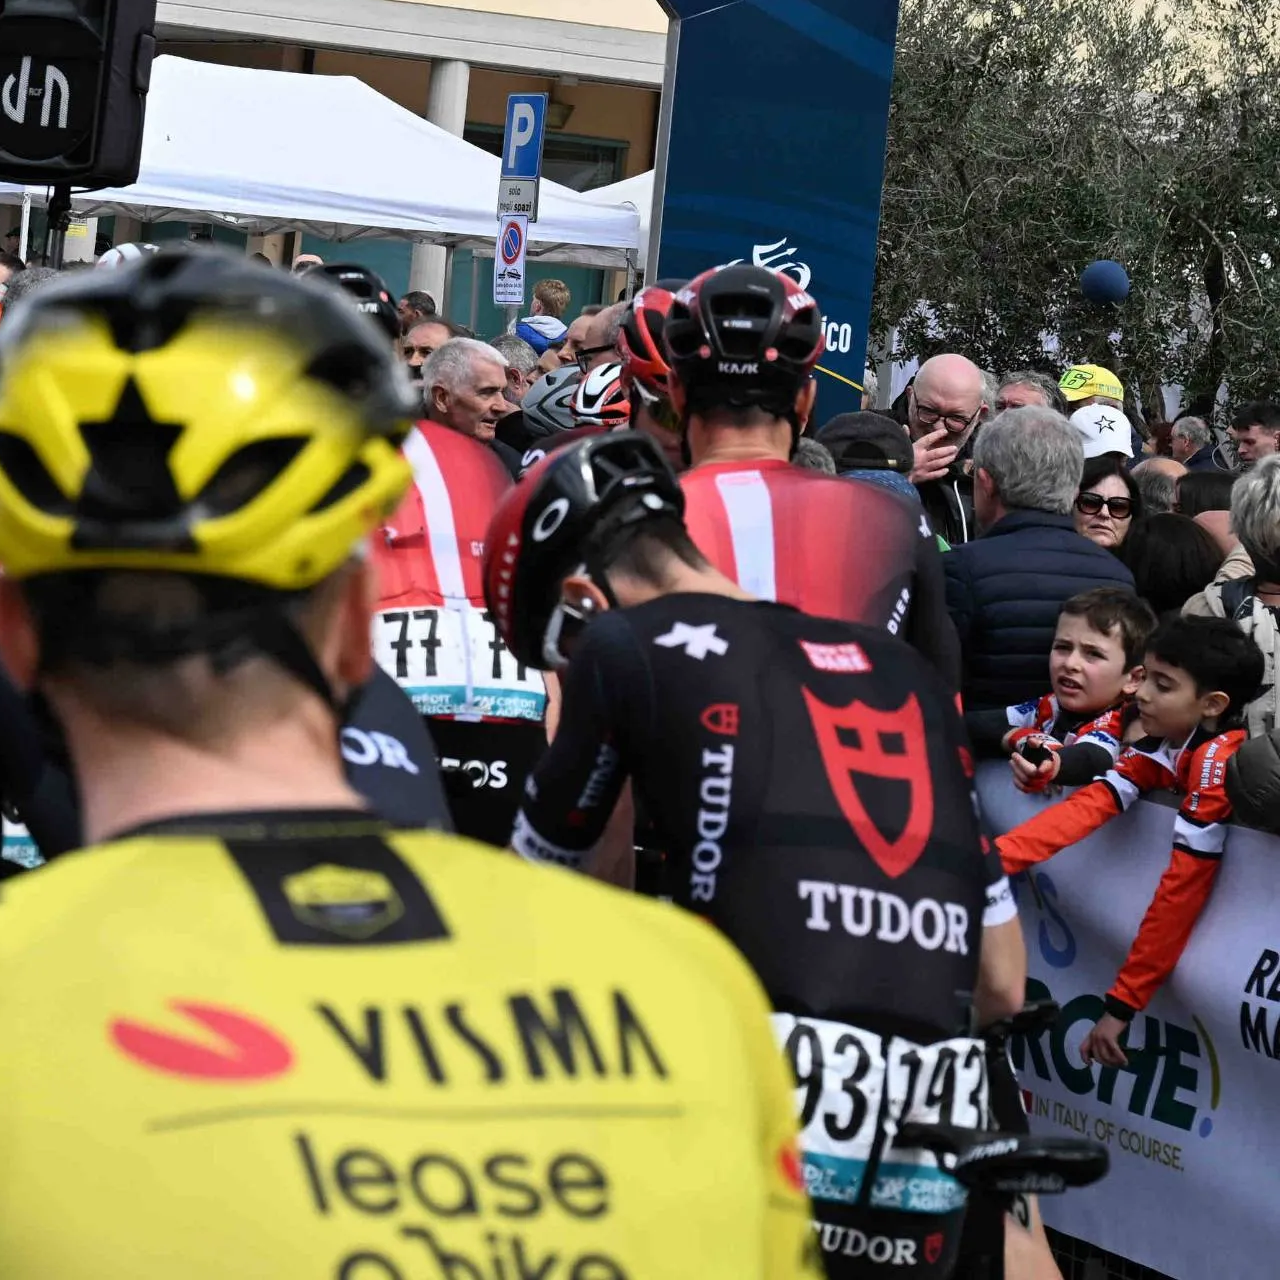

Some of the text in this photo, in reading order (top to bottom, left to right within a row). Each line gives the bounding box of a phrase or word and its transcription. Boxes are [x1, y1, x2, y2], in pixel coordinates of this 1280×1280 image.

[508, 103, 535, 169] P
[508, 185, 521, 196] solo
[513, 201, 532, 213] spazi
[382, 609, 442, 679] 77
[690, 743, 735, 903] TUDOR
[797, 879, 969, 957] TUDOR
[312, 986, 669, 1086] VISMA
[1034, 1094, 1185, 1173] IN ITALY, OF COURSE.
[293, 1133, 609, 1220] lease
[813, 1220, 918, 1266] UDOR
